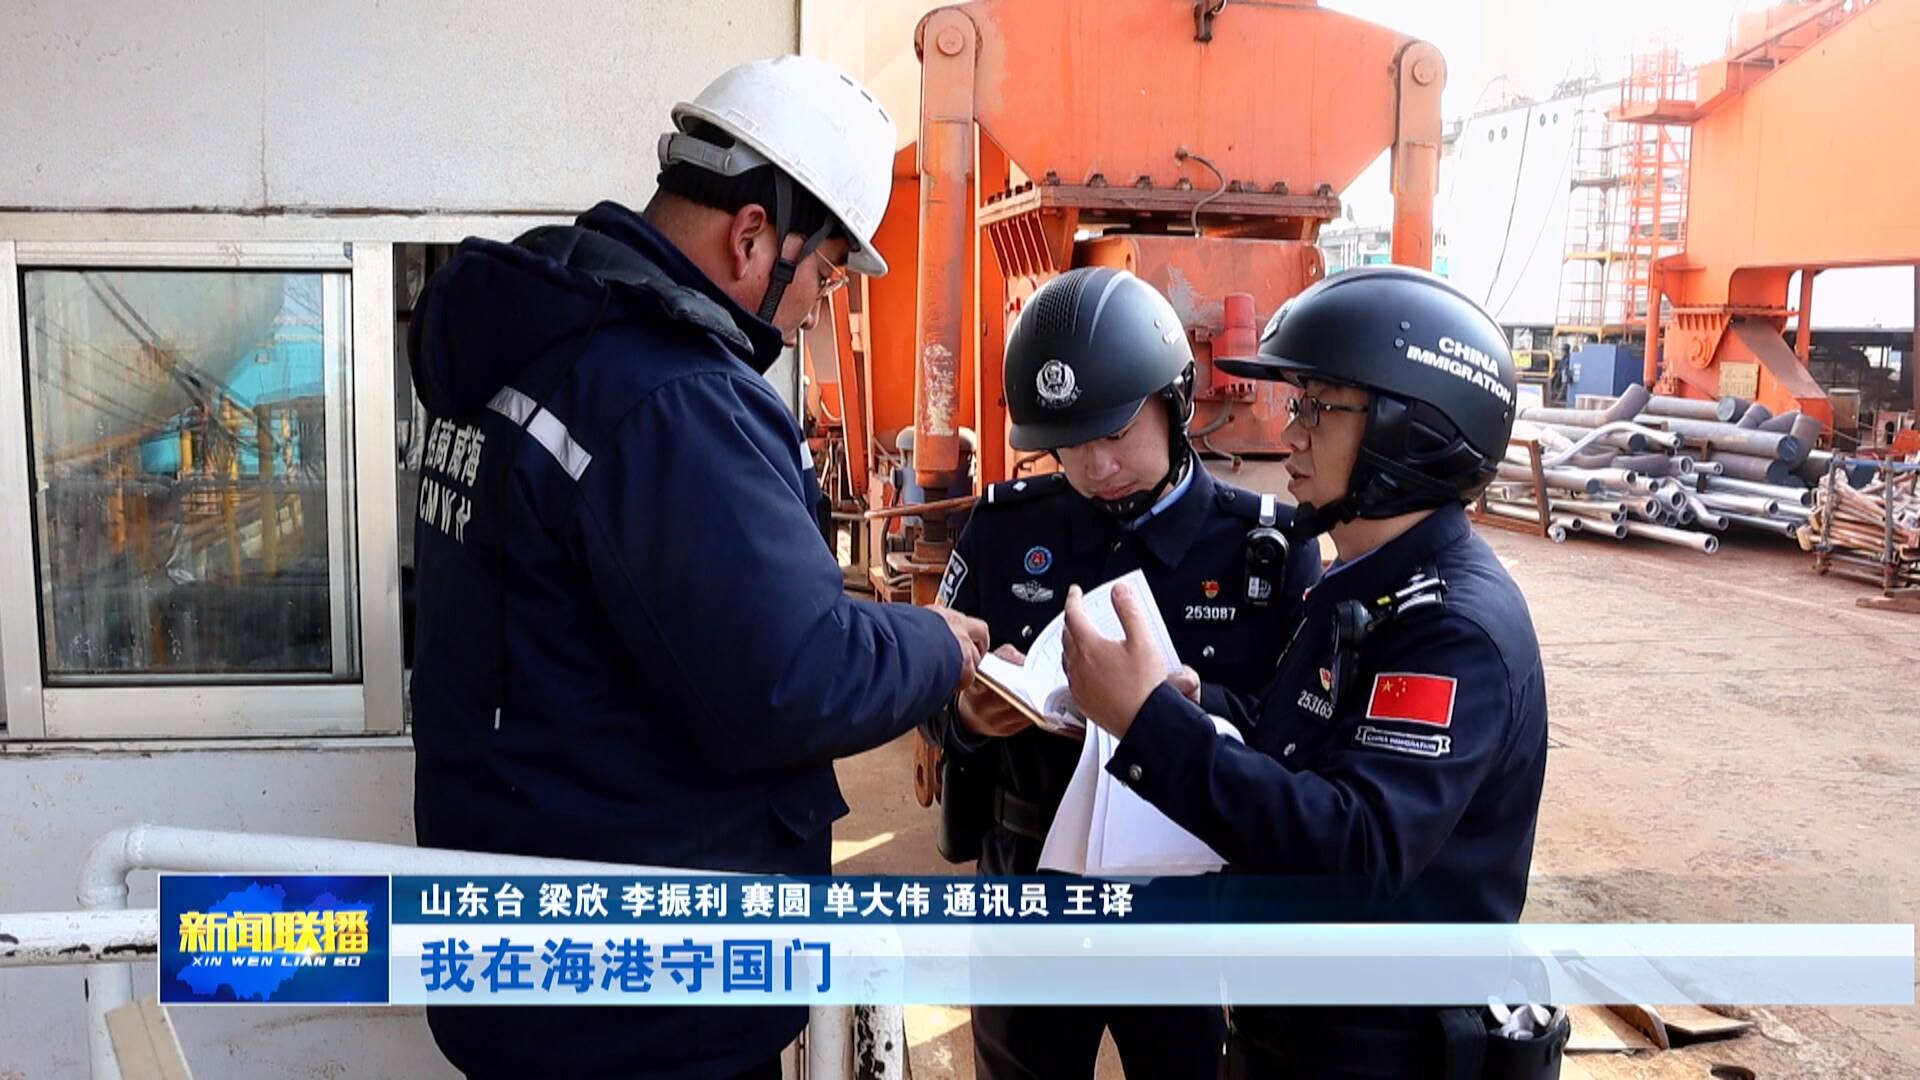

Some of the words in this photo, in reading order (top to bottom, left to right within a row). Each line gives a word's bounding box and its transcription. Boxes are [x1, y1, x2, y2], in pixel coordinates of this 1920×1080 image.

[1406, 345, 1512, 404] IMMIGRATION
[1438, 336, 1500, 377] CHINA
[1184, 604, 1237, 622] 253087
[1297, 689, 1335, 720] 253165
